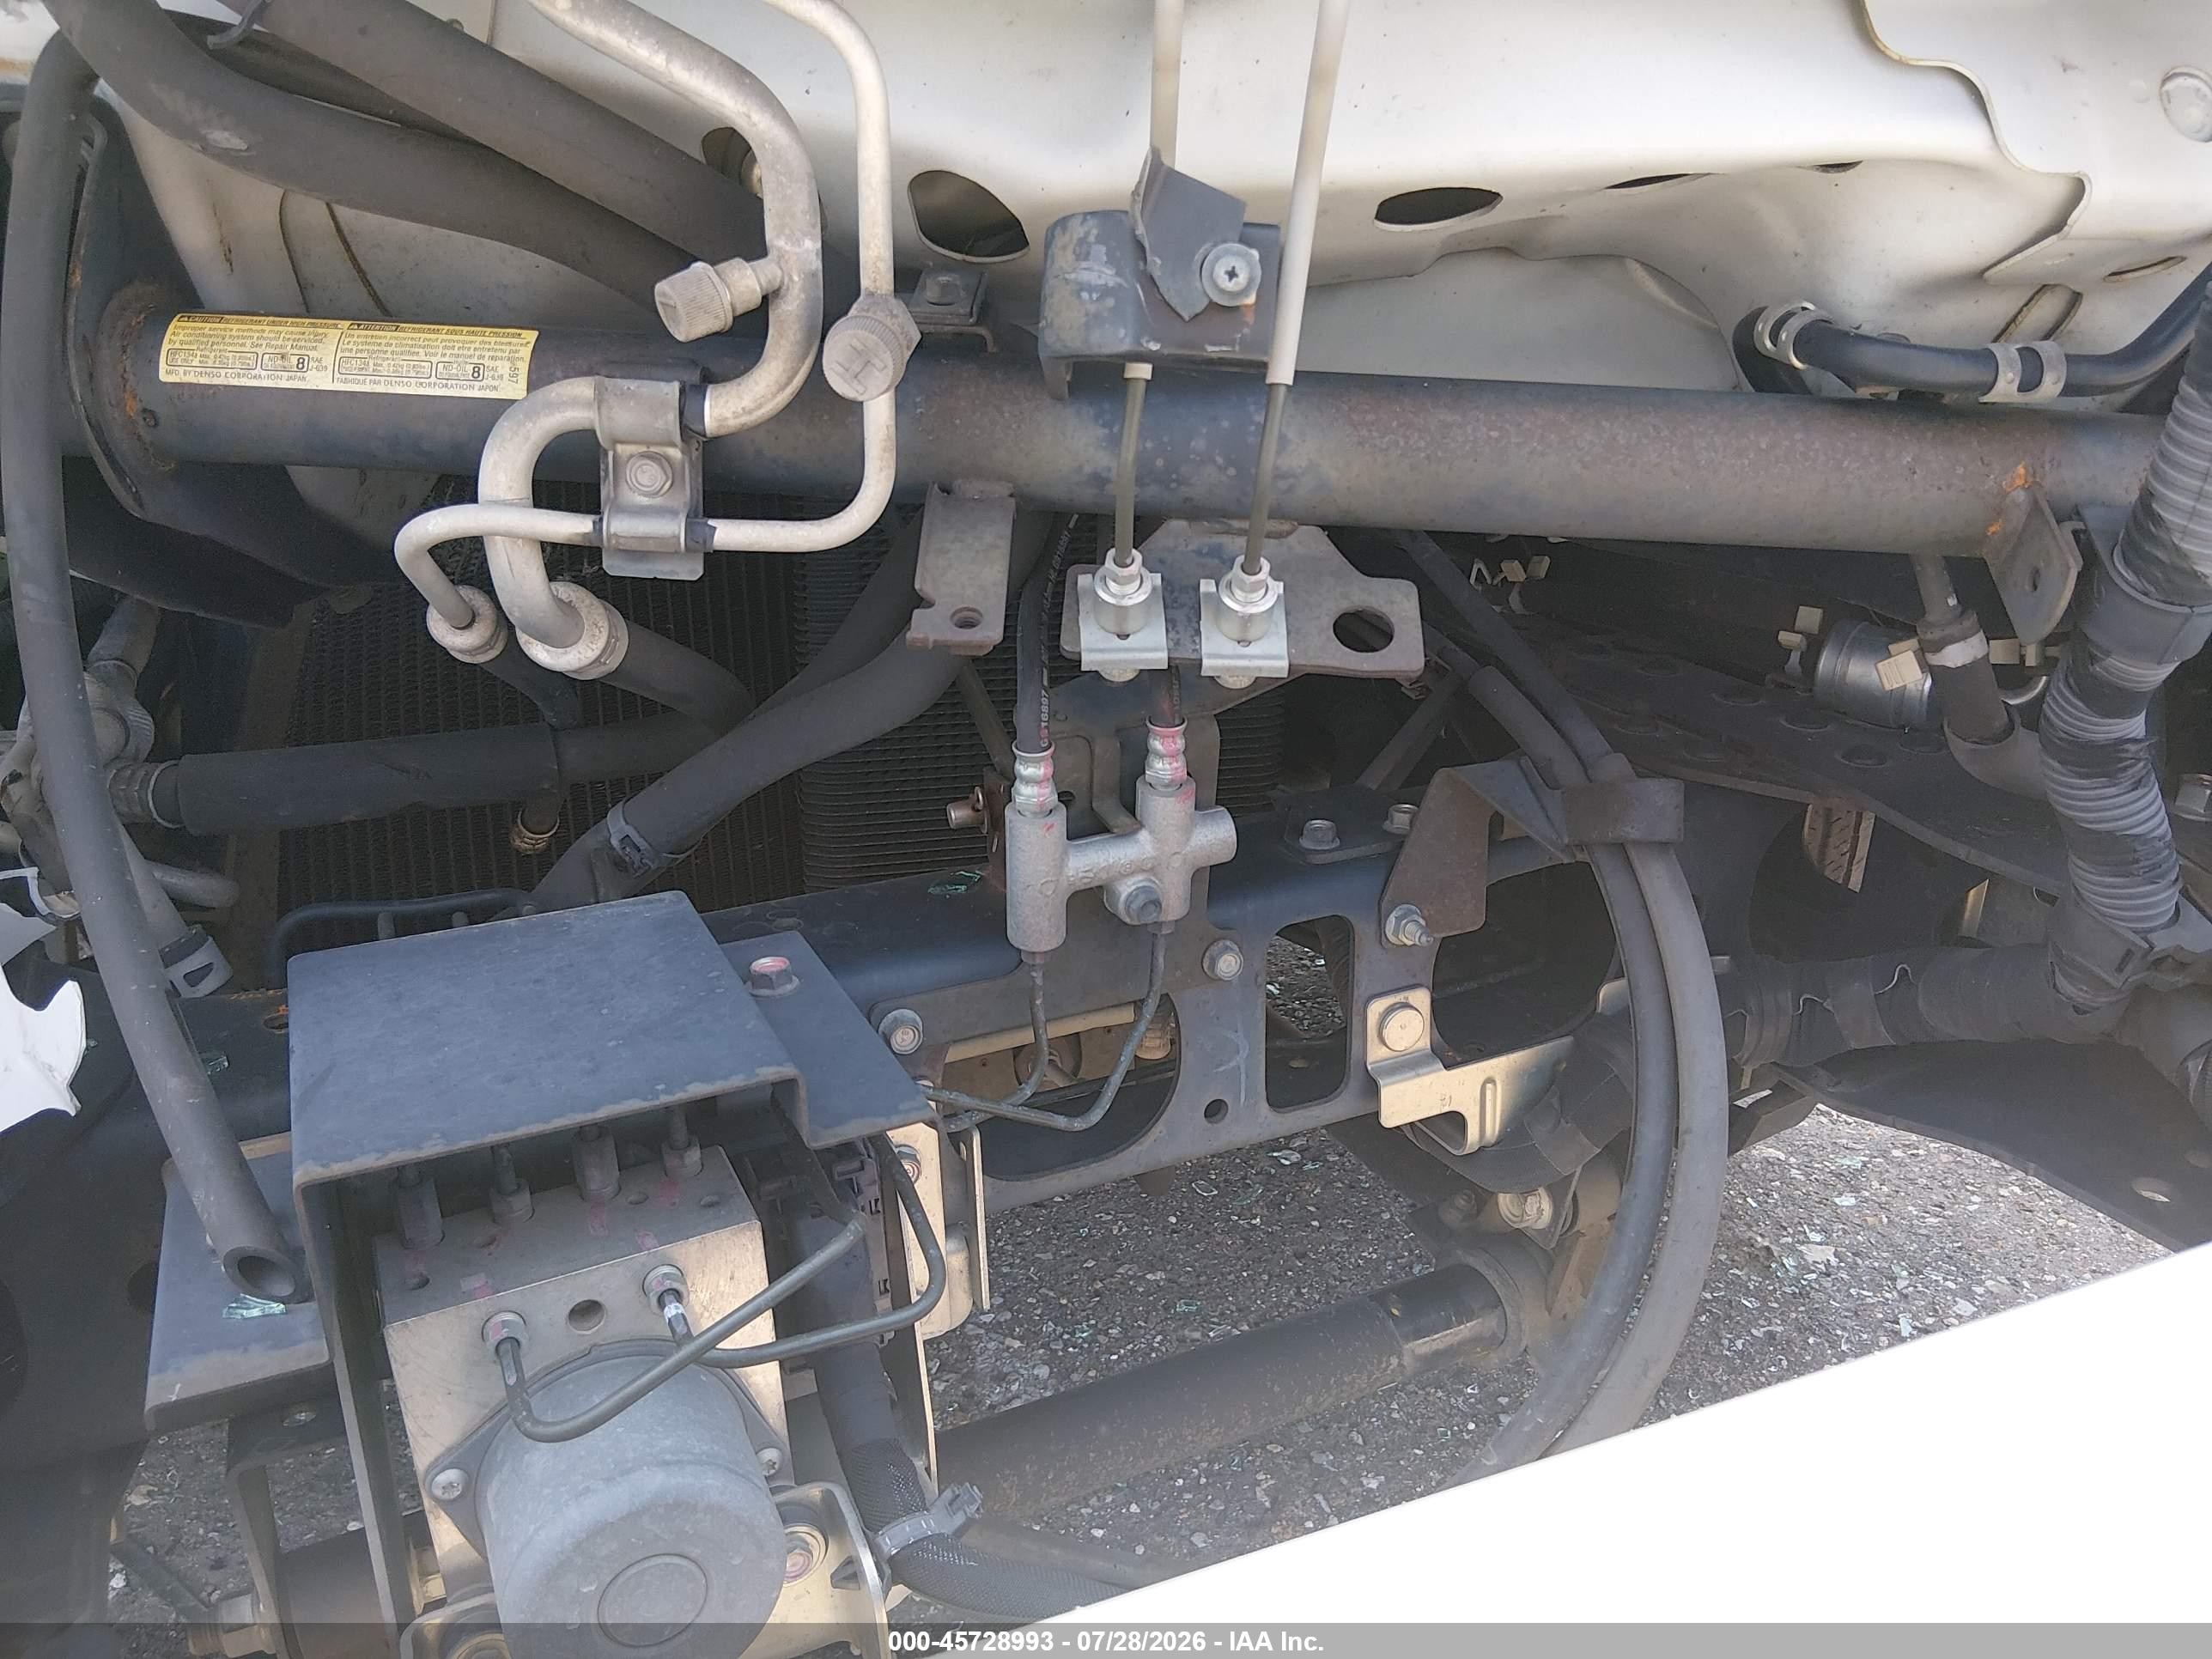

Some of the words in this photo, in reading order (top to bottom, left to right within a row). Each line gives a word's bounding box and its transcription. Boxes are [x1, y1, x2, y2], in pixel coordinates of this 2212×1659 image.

[173, 325, 207, 333] Improper
[264, 342, 288, 350] Repair
[295, 356, 306, 370] 8
[224, 371, 283, 380] CORPORATION
[471, 366, 481, 379] 8
[383, 379, 412, 387] DENSO
[415, 380, 475, 391] CORPORATION
